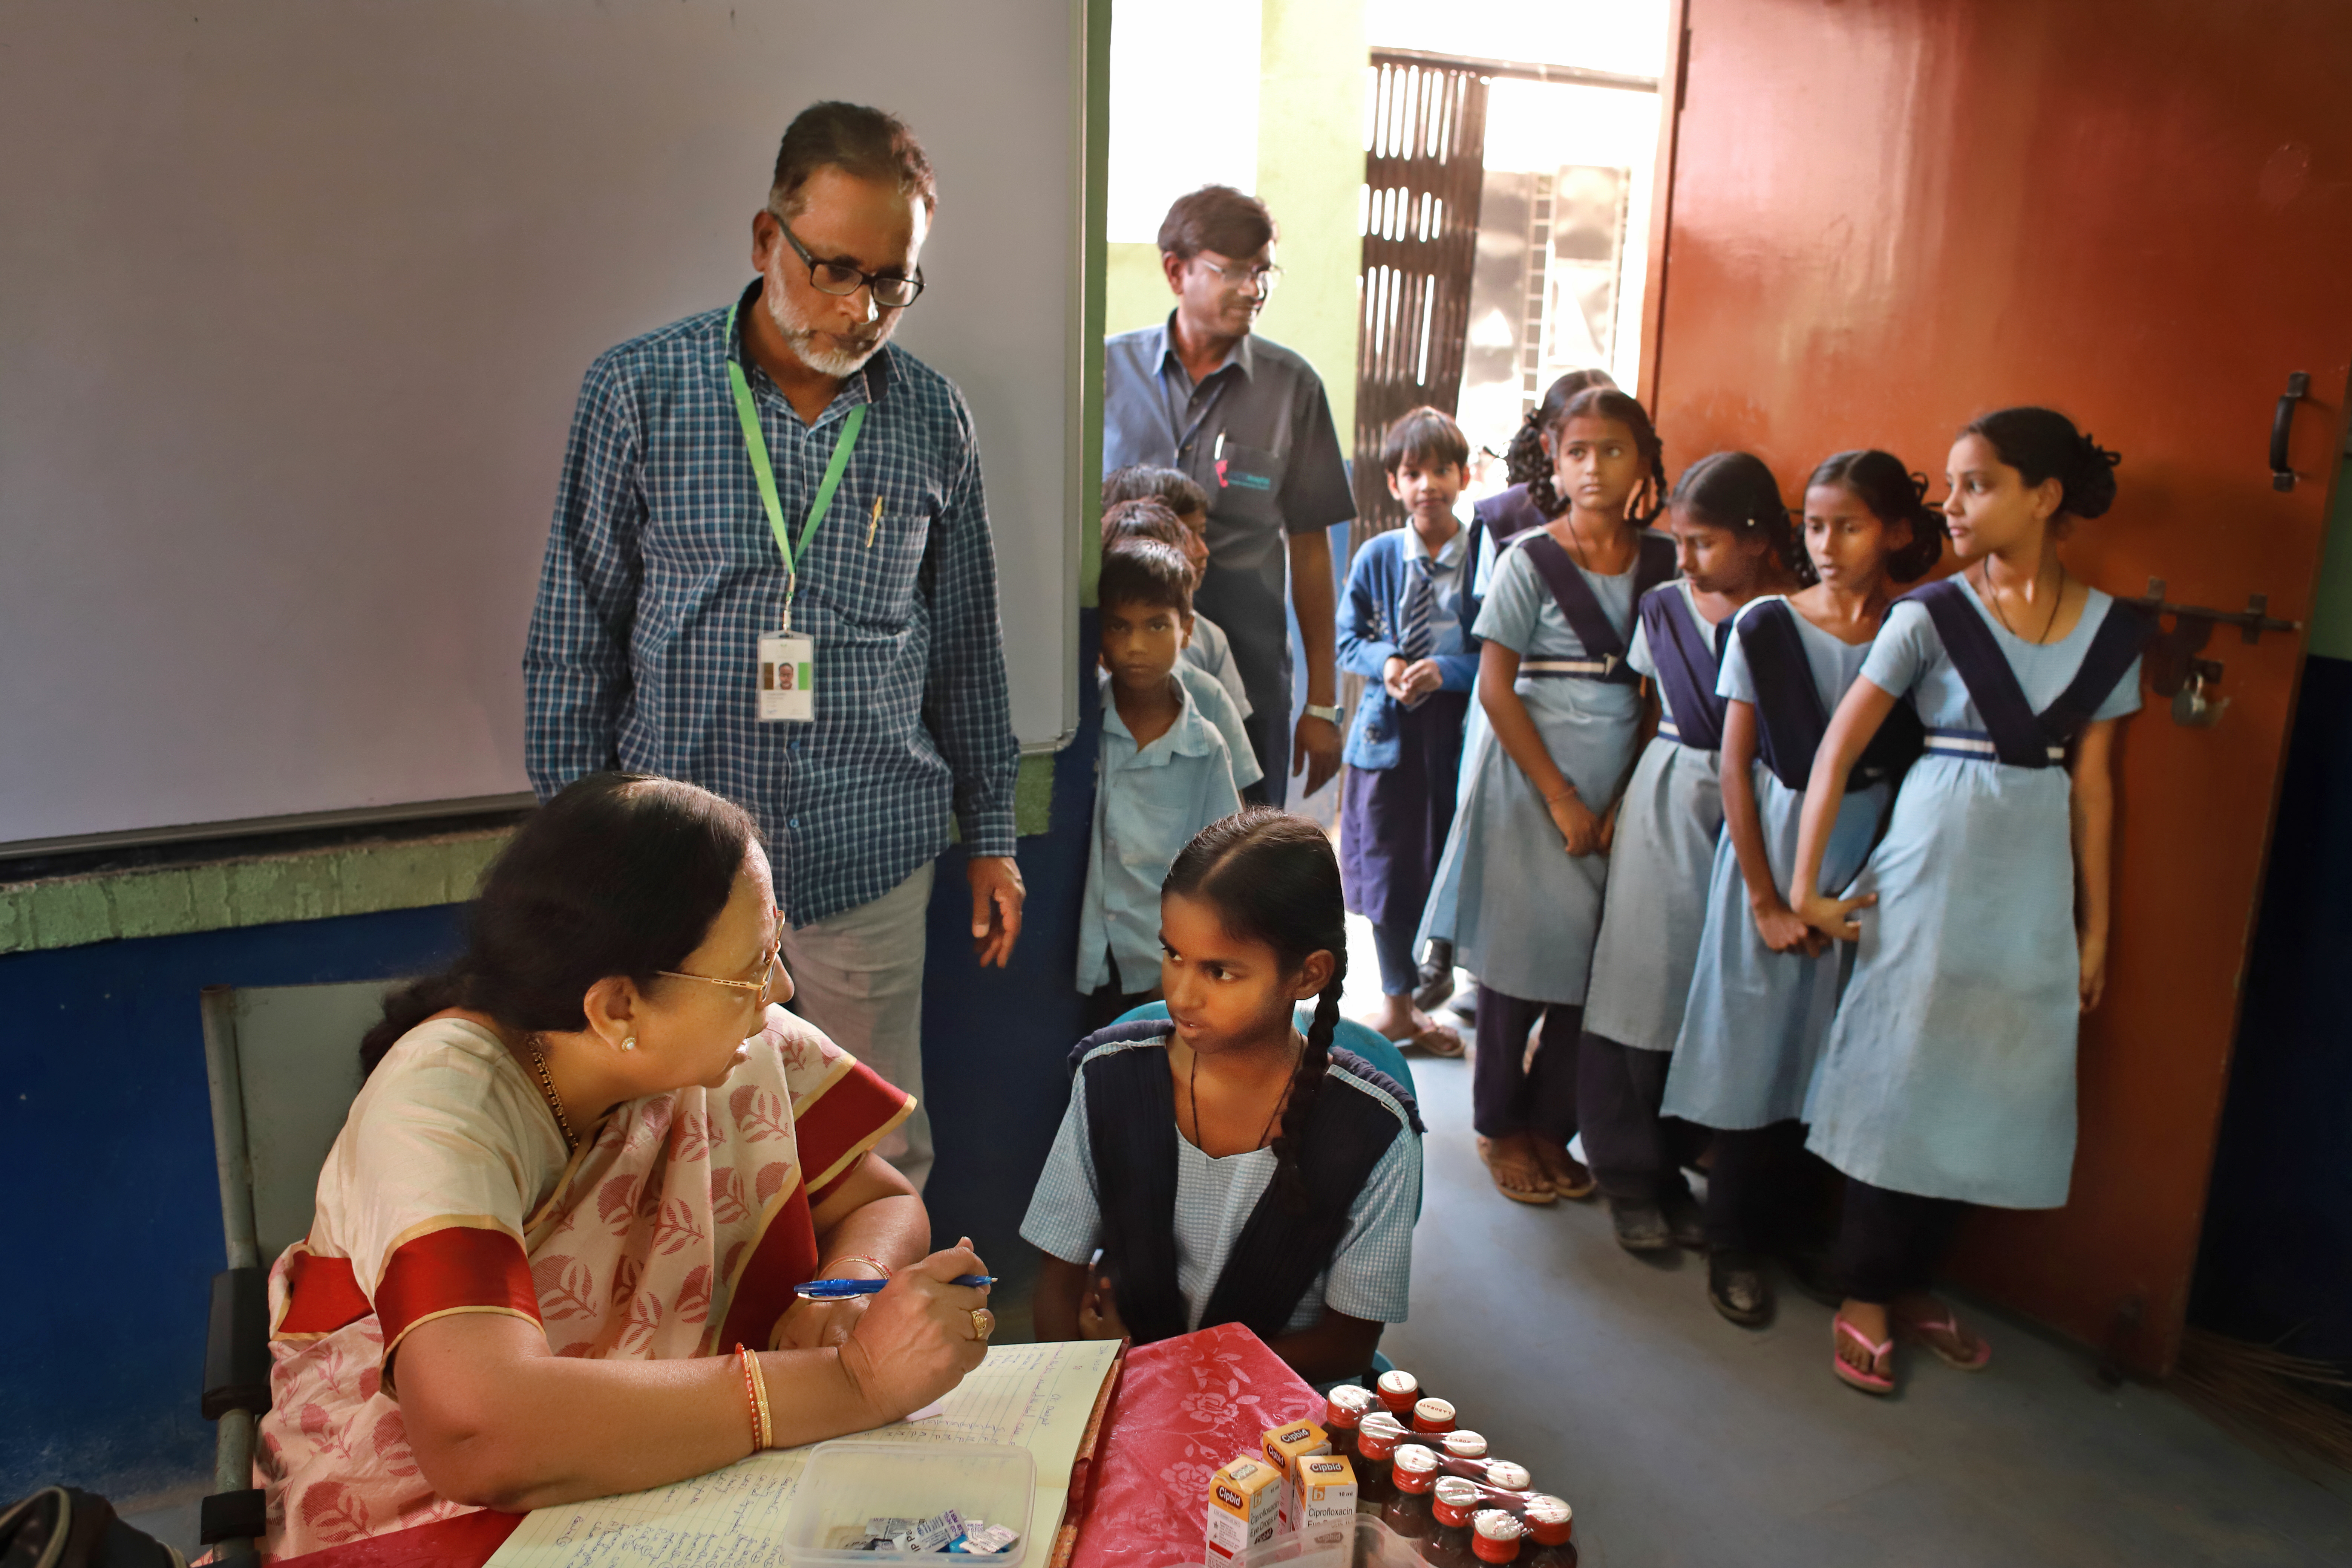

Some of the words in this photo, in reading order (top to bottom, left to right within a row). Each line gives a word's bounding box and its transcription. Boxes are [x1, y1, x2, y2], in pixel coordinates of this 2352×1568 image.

[1418, 1403, 1452, 1415] LABORATE
[1282, 1429, 1309, 1442] Cipbid
[1269, 1445, 1284, 1465] Cipbid
[1312, 1463, 1341, 1472] Cipbid
[1219, 1487, 1241, 1507] Cipbid
[1251, 1500, 1279, 1525] Ciprofloxacin
[1309, 1507, 1353, 1519] Ciprofloxacin
[1250, 1526, 1259, 1538] Eye
[1260, 1516, 1274, 1531] Drops
[1274, 1510, 1279, 1521] IP
[911, 1543, 921, 1552] IP
